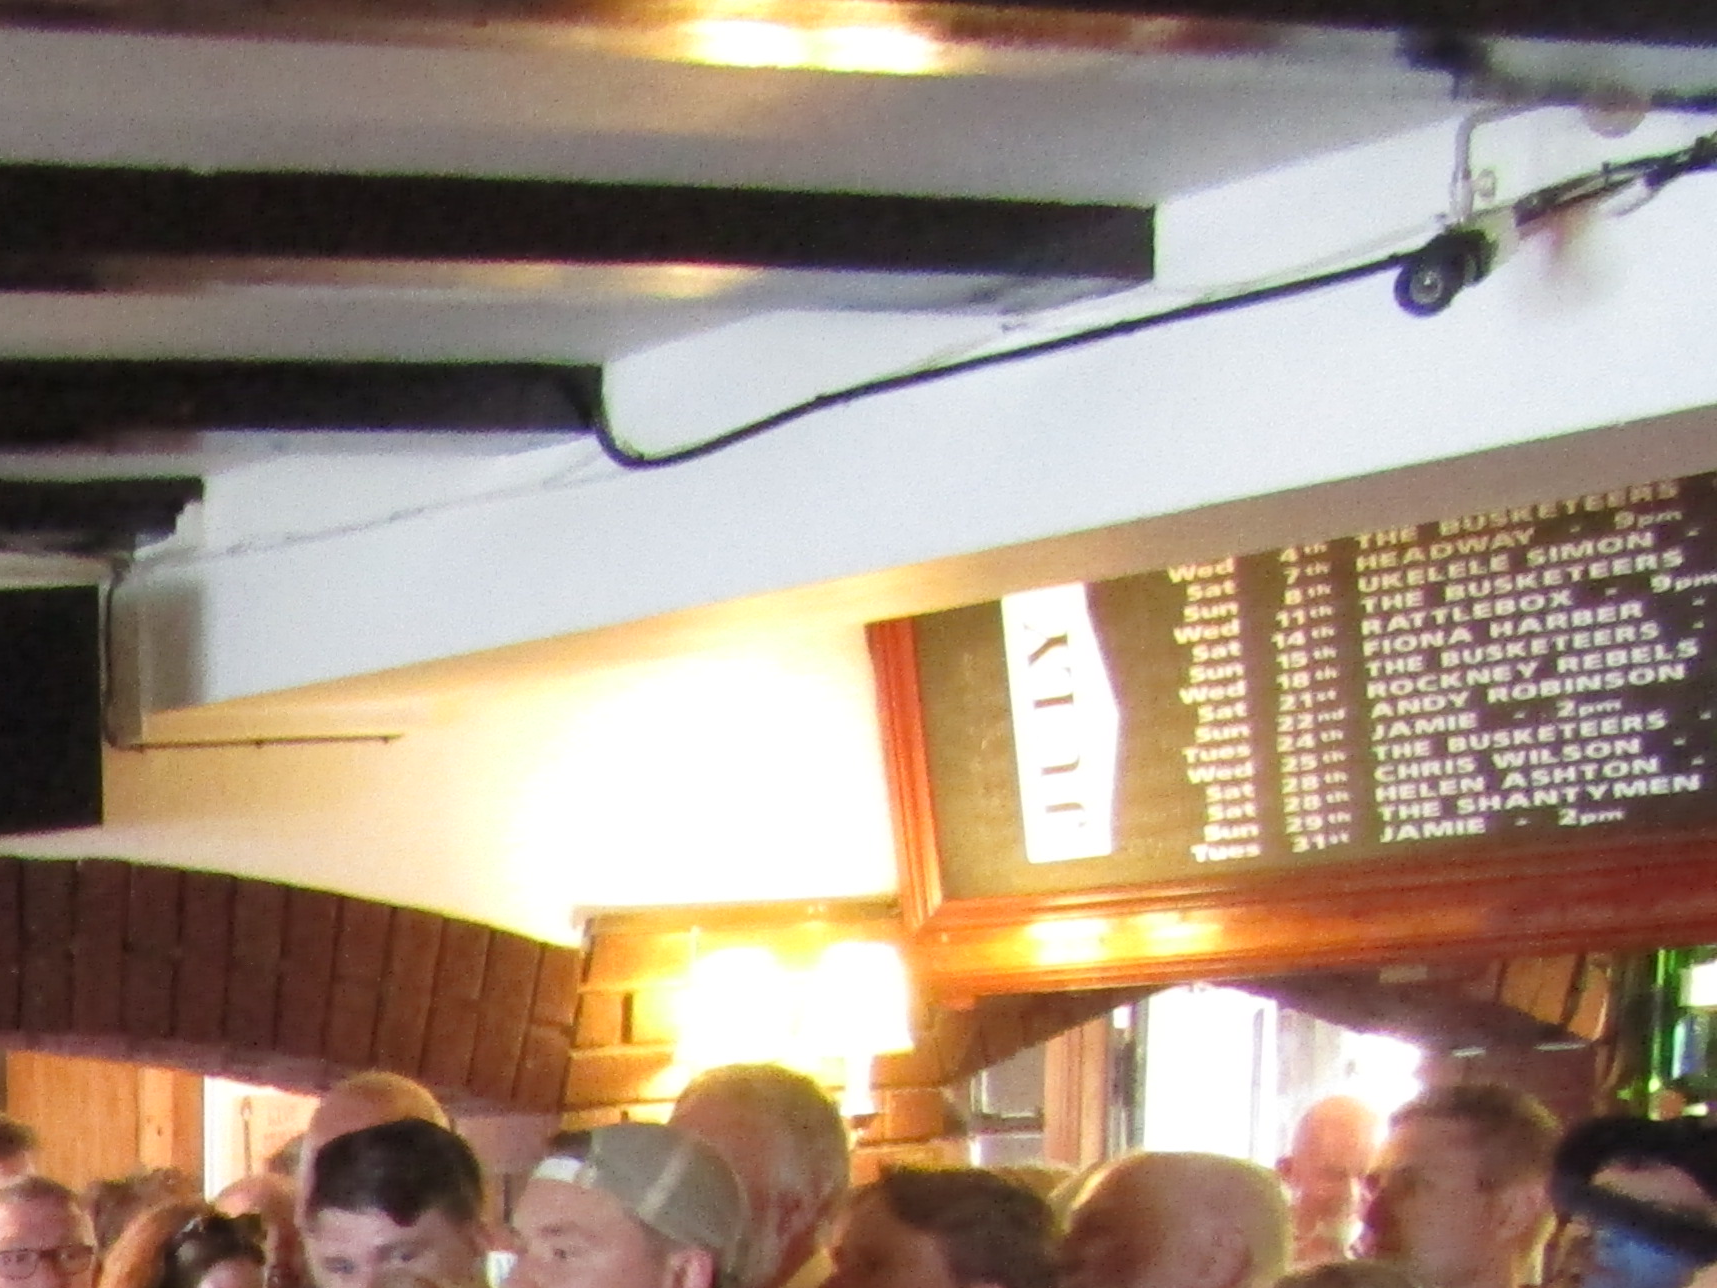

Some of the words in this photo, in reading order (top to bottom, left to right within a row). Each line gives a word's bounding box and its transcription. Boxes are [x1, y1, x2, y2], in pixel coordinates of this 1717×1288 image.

[1167, 556, 1235, 583] Wed
[1183, 601, 1239, 622] Sun
[1358, 553, 1509, 593] UKELELE
[1527, 531, 1653, 567] SIMON
[1186, 579, 1237, 601] Sat
[1283, 561, 1331, 585] 7th
[1356, 527, 1535, 572] HEADWAY
[1615, 510, 1683, 530] 9pm
[1173, 618, 1240, 644] Wed
[1361, 589, 1424, 613] THE
[1445, 548, 1684, 602] BUSKETEERS
[1191, 639, 1243, 662] Sat
[1361, 589, 1573, 635] RATTLEBOX
[1179, 679, 1246, 705] Wed
[1365, 655, 1424, 677] THE
[1441, 620, 1659, 668] BUSKETEERS
[1189, 661, 1245, 684] Sun
[1363, 626, 1473, 657] FIONA
[1490, 601, 1643, 638] HARBER
[1195, 722, 1250, 743] Sun
[1371, 691, 1470, 719] ANDY
[1487, 663, 1685, 703] ROBINSON
[1198, 702, 1247, 723] Sat
[1367, 660, 1539, 699] ROCKNEY
[1556, 638, 1698, 673] REBELS
[1182, 744, 1251, 764] Tues
[1371, 711, 1478, 741] JAMIE
[1556, 699, 1621, 718] 2pm
[1187, 760, 1255, 784] Wed
[1372, 739, 1432, 761] THE
[1447, 709, 1667, 753] BUSKETEERS
[1205, 782, 1256, 803] Sat
[1374, 755, 1477, 782] CHRIS
[1492, 737, 1641, 769] WILSON
[1207, 801, 1257, 822] Sat
[1375, 776, 1485, 802] HELEN
[1501, 755, 1659, 789] ASHTON
[1191, 842, 1261, 863] Tues
[1380, 816, 1486, 843] JAMIE
[1558, 808, 1624, 826] 2pm
[1203, 823, 1259, 843] Sun
[1379, 799, 1441, 821] THE
[1456, 773, 1701, 814] SHANTYMEN
